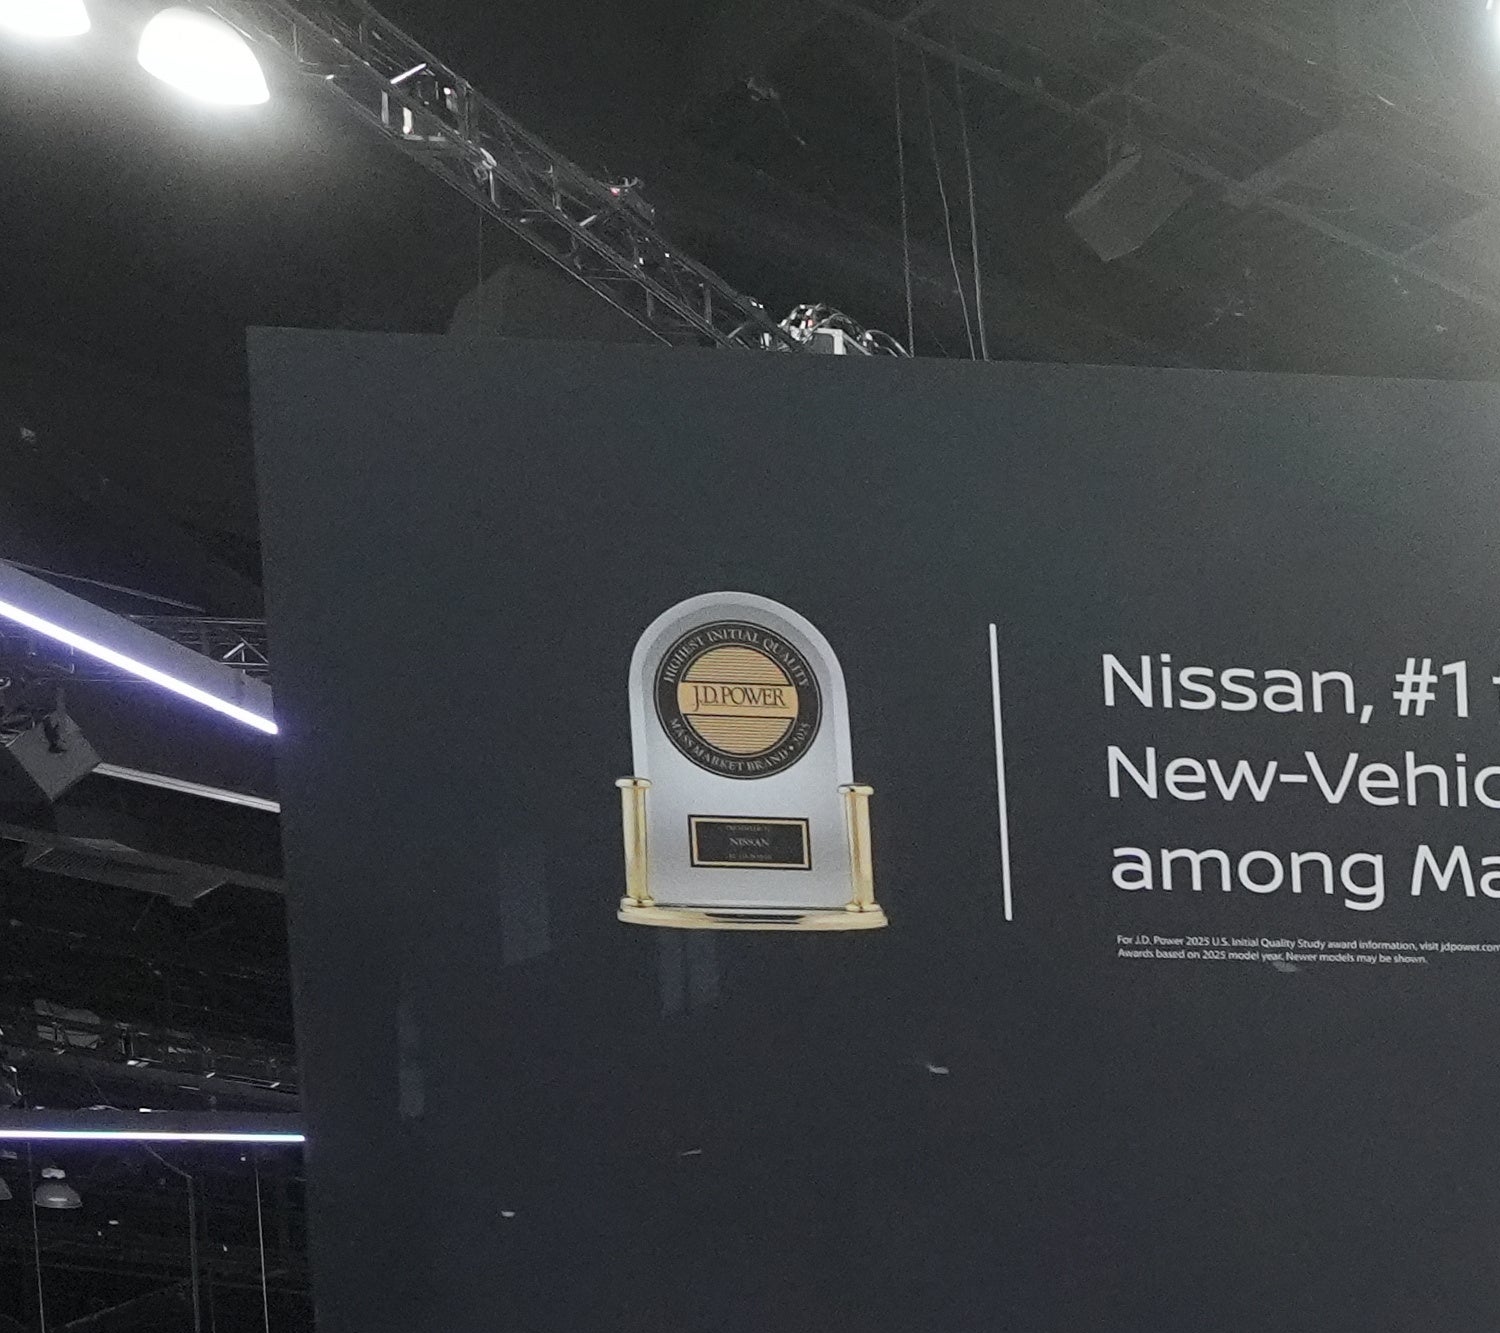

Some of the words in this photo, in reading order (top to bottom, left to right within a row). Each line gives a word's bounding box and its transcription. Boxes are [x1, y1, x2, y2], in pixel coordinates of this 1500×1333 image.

[664, 636, 704, 684] HIGHEST
[707, 628, 760, 644] INITIAL
[763, 638, 810, 687] QUALITY
[693, 685, 719, 712] J.D.
[722, 686, 786, 706] POWER
[1102, 653, 1373, 723] Nissan,
[1393, 657, 1469, 718] #1
[669, 718, 695, 747] MASS
[694, 745, 746, 772] MARKET
[746, 749, 789, 771] BRAND
[1110, 846, 1386, 910] among
[1117, 935, 1133, 945] For
[1153, 935, 1184, 946] Power
[1186, 936, 1210, 946] 2025
[1211, 936, 1231, 947] U.S.
[1231, 937, 1259, 948] Initial
[1261, 937, 1296, 950] Quality
[1297, 938, 1326, 951] Study
[1327, 940, 1357, 949] award
[1359, 940, 1418, 951] information,
[1419, 941, 1439, 951] visit
[1118, 948, 1154, 958] Awards
[1155, 949, 1185, 958] based
[1187, 951, 1200, 959] on
[1202, 949, 1226, 960] 2025
[1228, 950, 1260, 961] model
[1285, 951, 1317, 961] Newer
[1319, 953, 1355, 962] models
[1356, 954, 1377, 964] may
[1379, 953, 1392, 963] be
